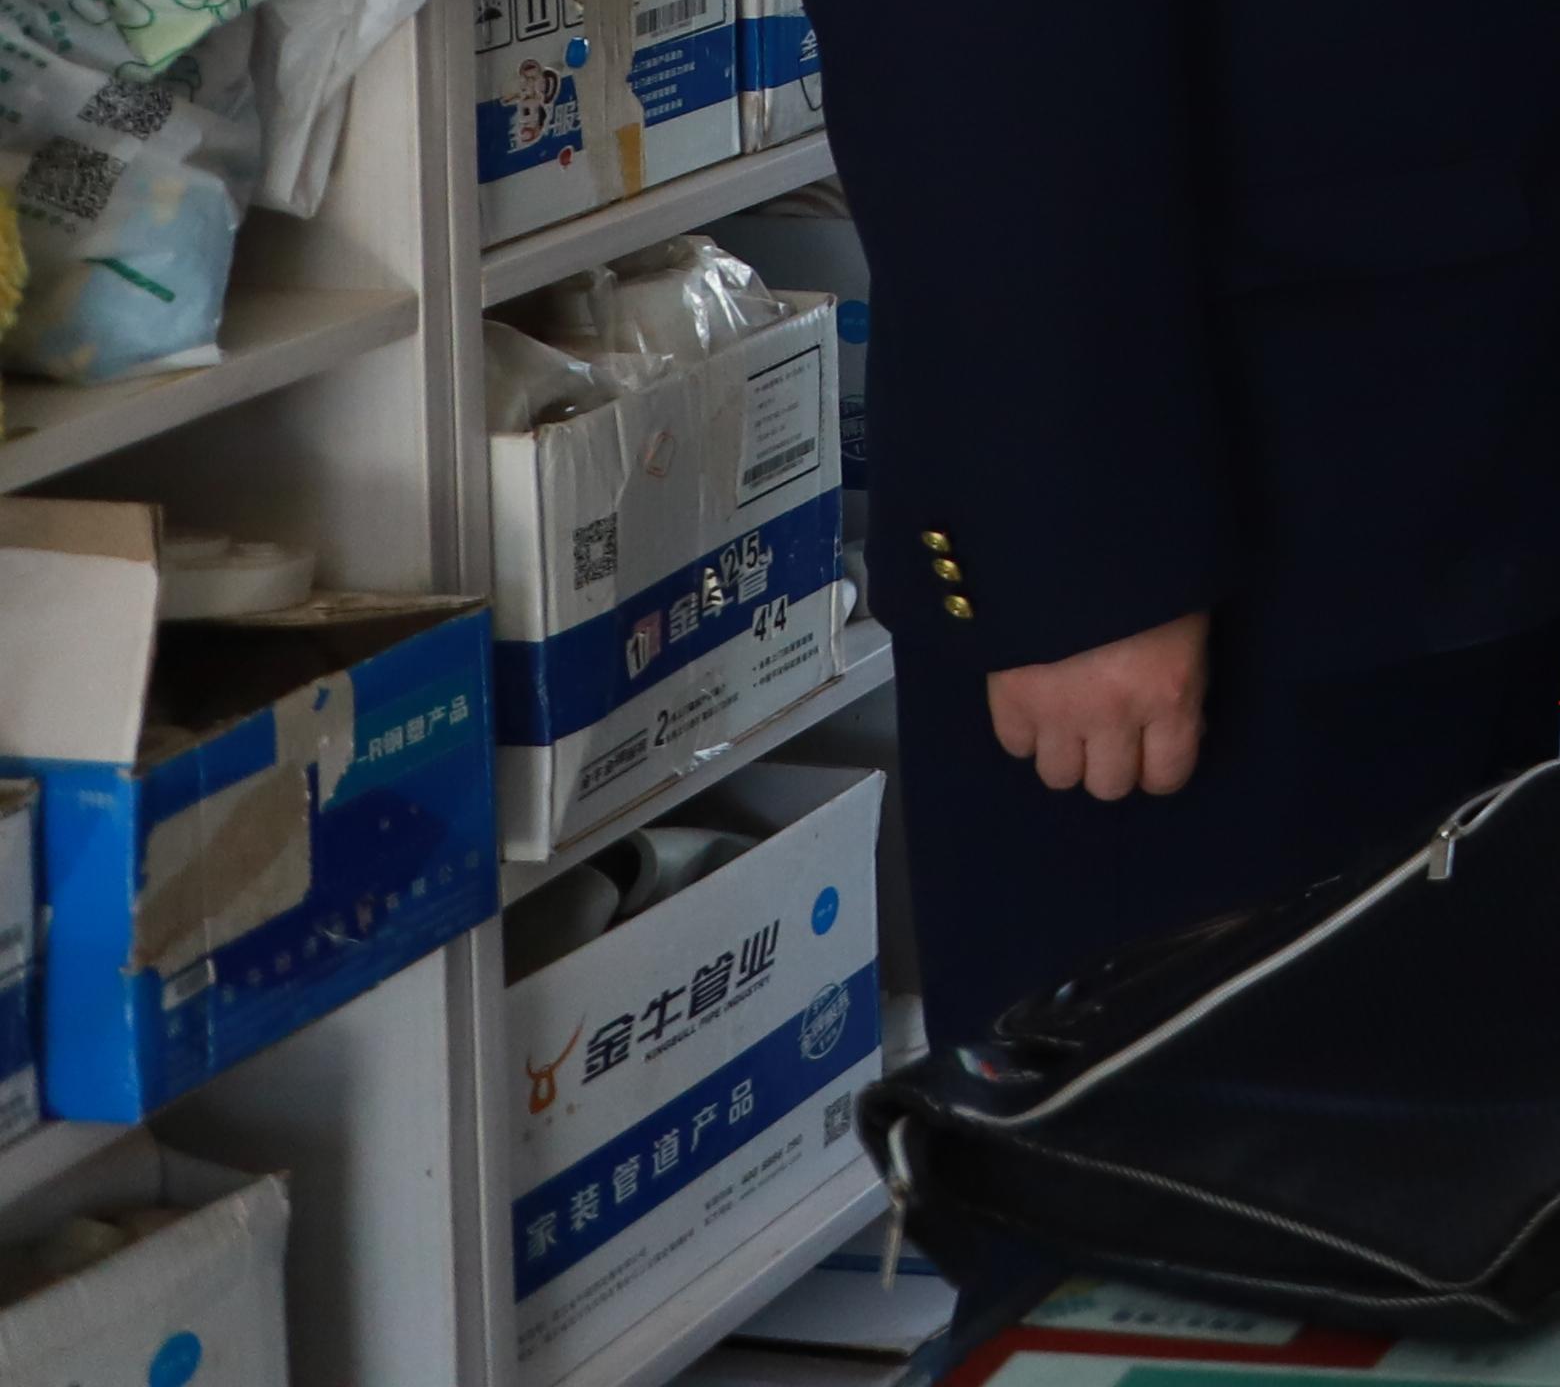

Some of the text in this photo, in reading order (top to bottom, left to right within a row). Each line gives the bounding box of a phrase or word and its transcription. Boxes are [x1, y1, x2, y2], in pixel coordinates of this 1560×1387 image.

[582, 919, 781, 1086] 金牛管业
[526, 1078, 754, 1262] 家装管道产品
